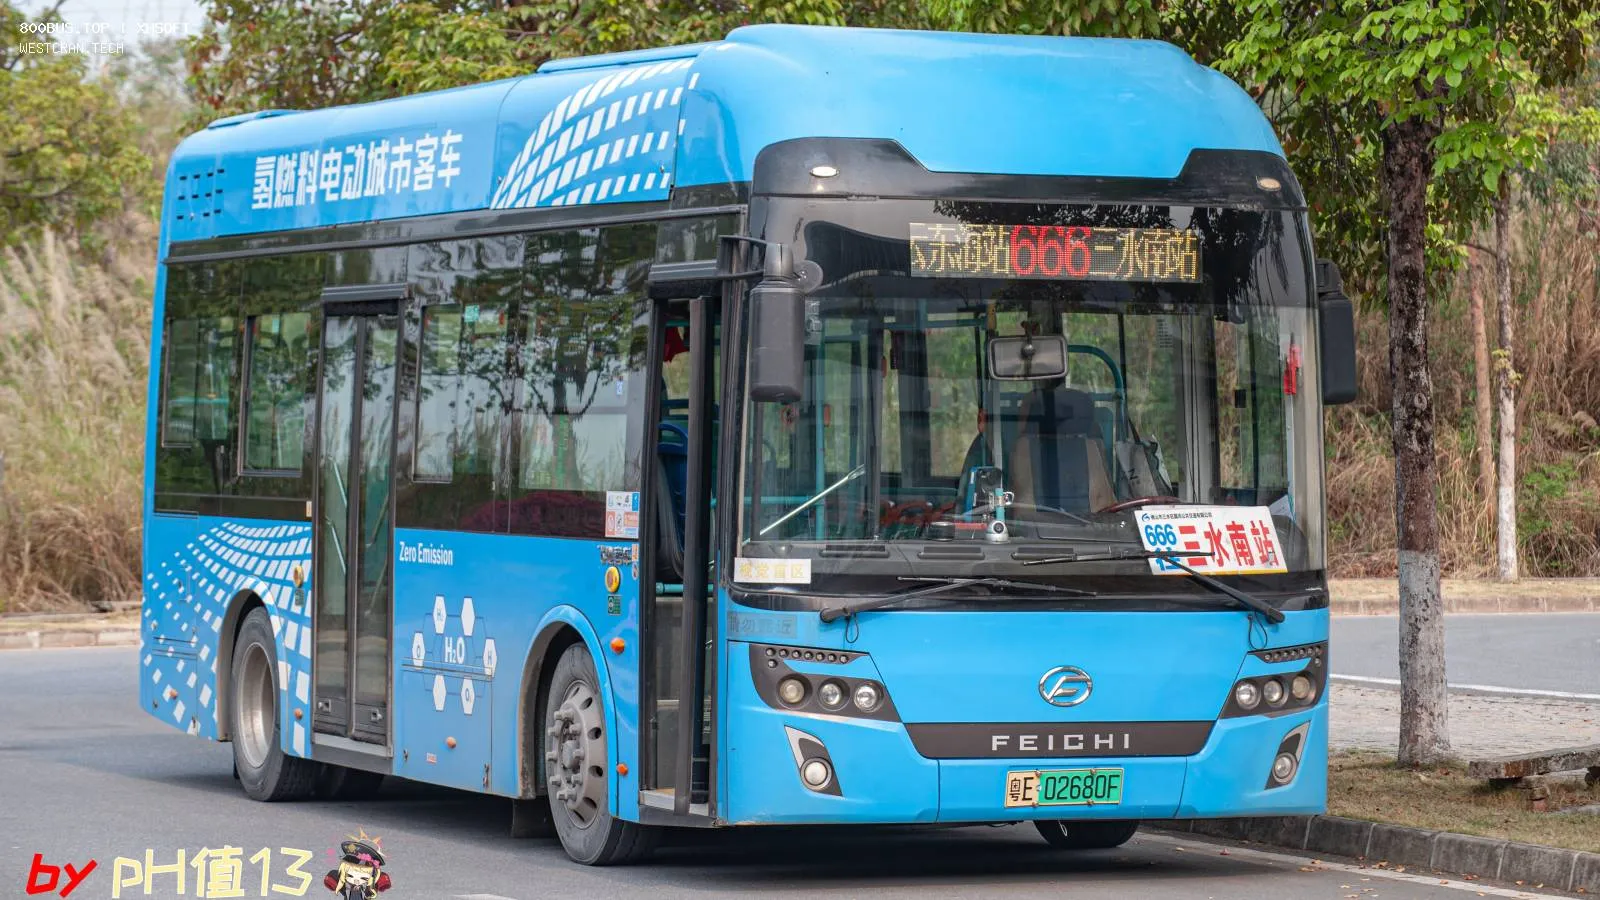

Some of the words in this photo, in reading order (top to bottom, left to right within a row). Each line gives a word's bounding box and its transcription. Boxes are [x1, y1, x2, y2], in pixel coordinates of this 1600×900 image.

[251, 129, 463, 210] 氢燃料电动城市客车
[1010, 224, 1092, 276] 666
[1144, 523, 1177, 546] 666
[1178, 520, 1280, 568] 三水南站
[399, 541, 417, 563] Zero
[418, 543, 454, 566] Emission
[991, 733, 1130, 751] FEICHI
[1044, 774, 1120, 800] 02680F
